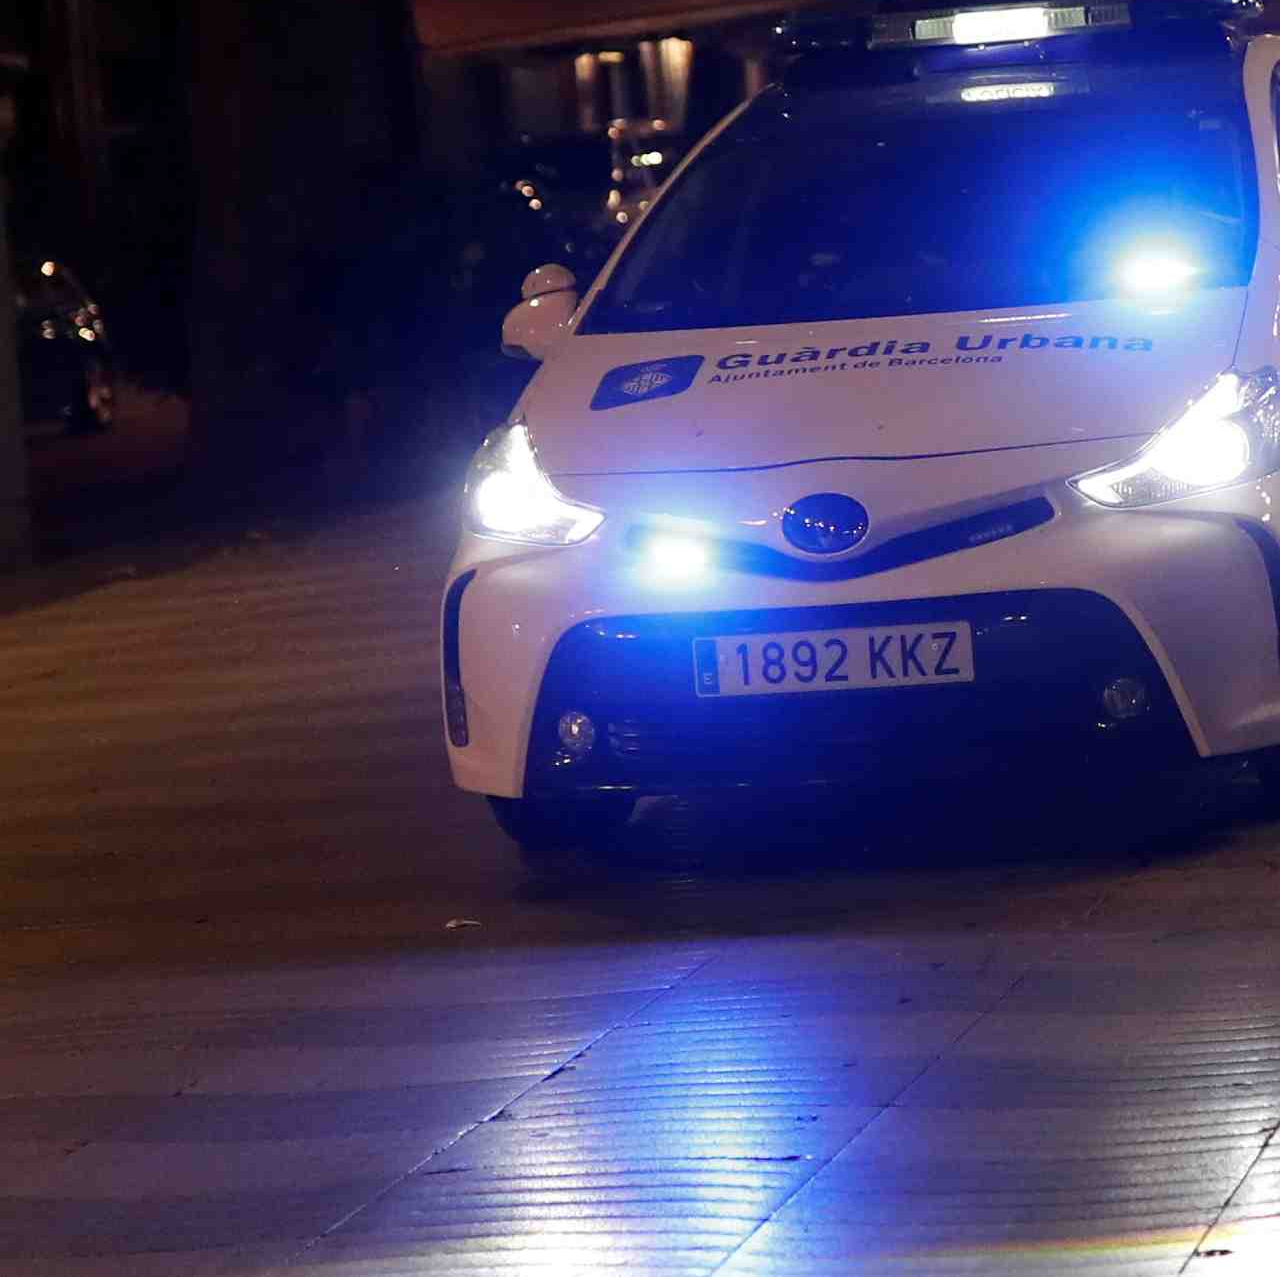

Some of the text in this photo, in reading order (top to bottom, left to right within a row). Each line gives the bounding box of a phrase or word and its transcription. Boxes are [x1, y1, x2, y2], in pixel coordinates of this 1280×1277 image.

[708, 353, 1003, 385] Ajuntament de Barcelona
[716, 332, 1153, 370] Guàrdia Urbana
[735, 630, 961, 686] 1892 KKZ
